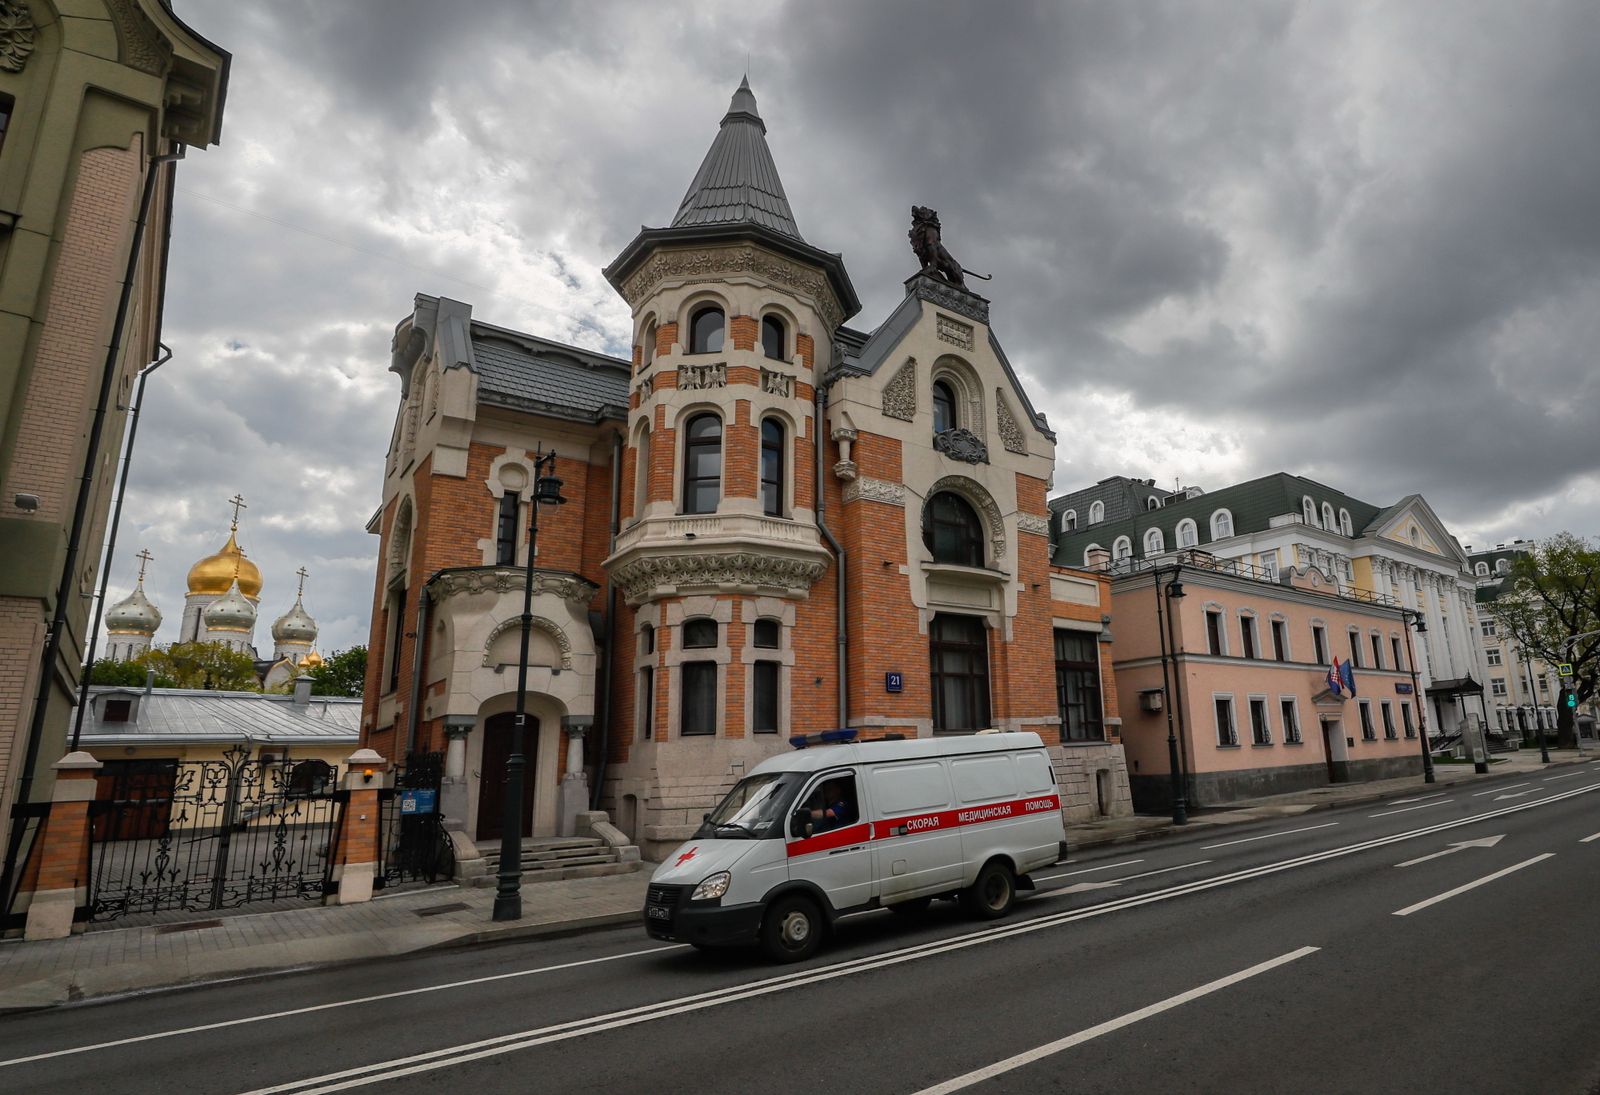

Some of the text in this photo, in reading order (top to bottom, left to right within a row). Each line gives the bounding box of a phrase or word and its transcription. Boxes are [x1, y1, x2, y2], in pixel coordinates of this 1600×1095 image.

[891, 676, 900, 685] 21
[906, 800, 1054, 830] СКОРАЯ МЕДИЦИНСКАЯ ПОМОЩЬ
